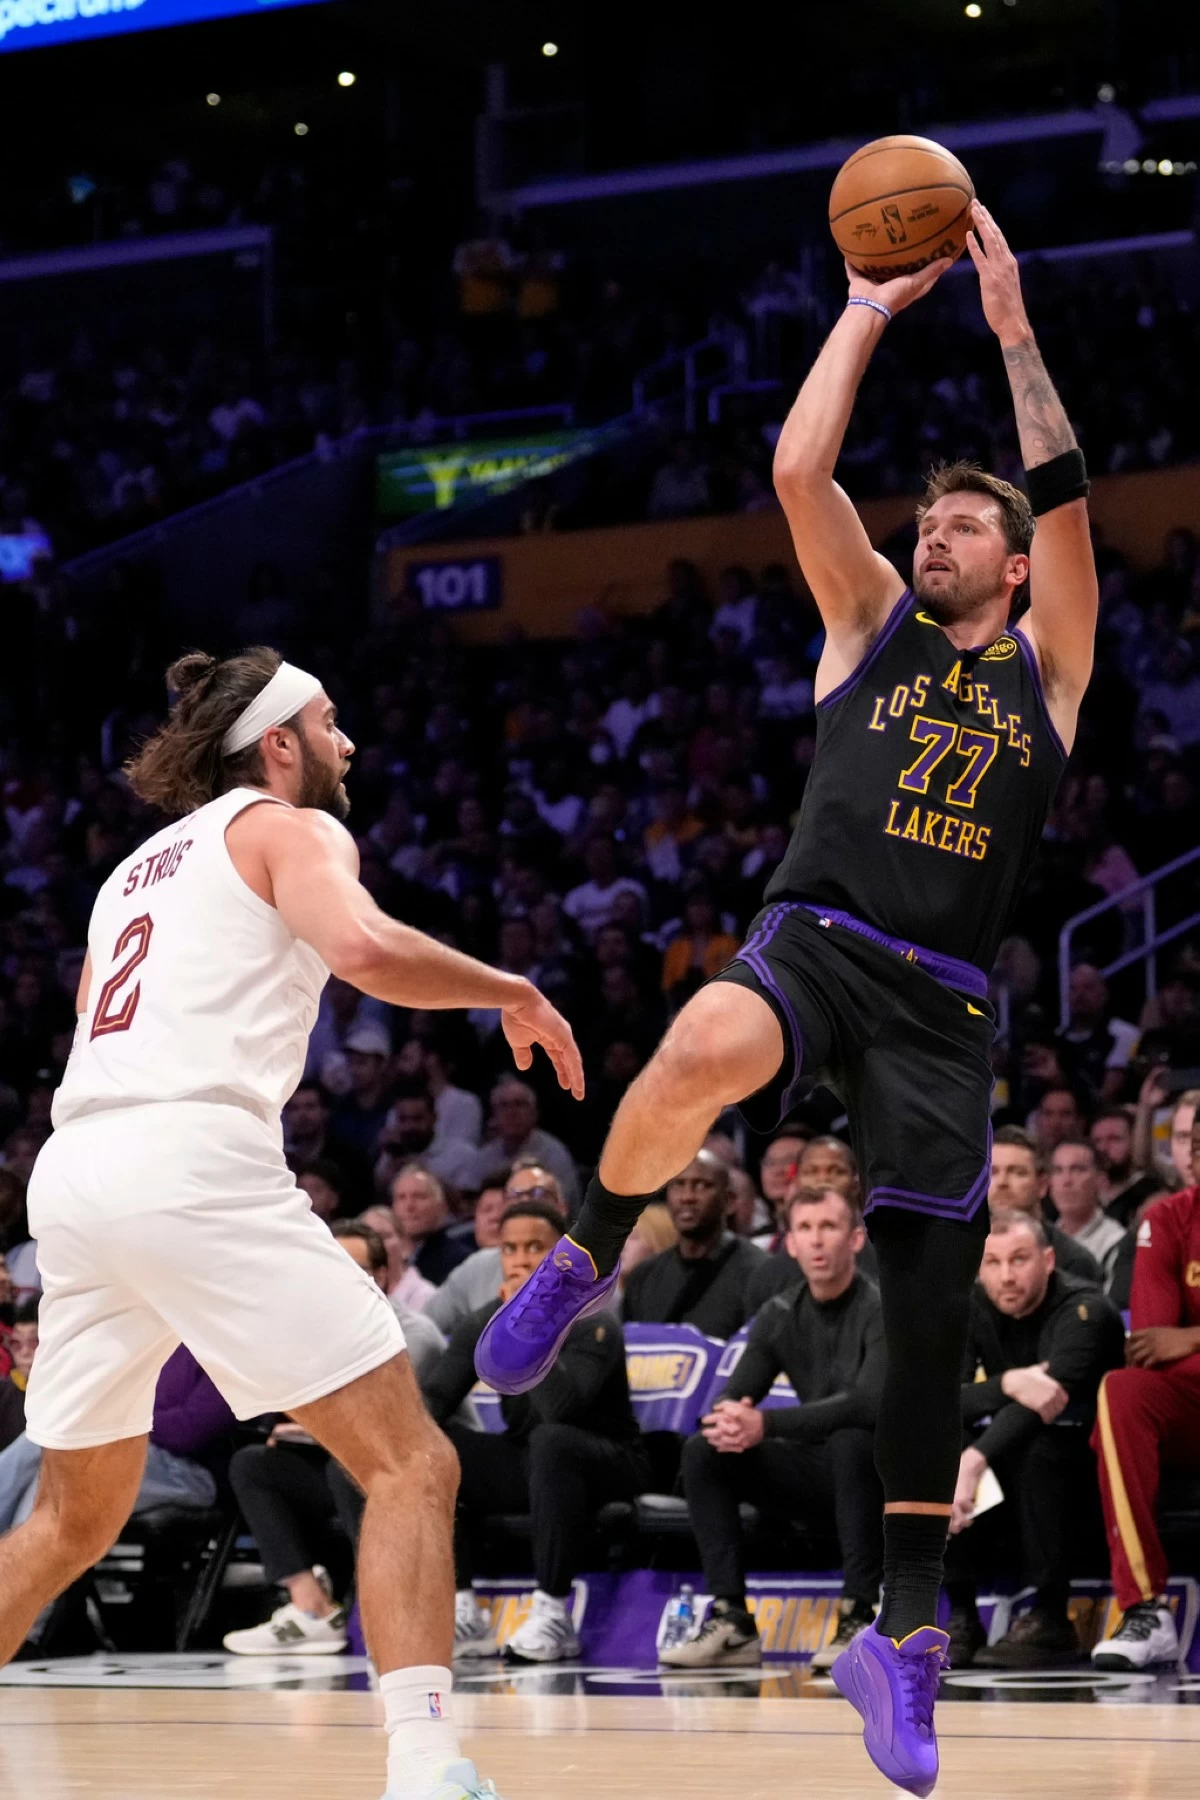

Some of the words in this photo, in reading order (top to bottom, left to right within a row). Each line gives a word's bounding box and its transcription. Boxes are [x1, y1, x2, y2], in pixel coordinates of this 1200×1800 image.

[417, 563, 486, 608] 101
[868, 674, 932, 732] LOS
[941, 660, 1032, 767] AGELES
[898, 714, 999, 808] 77
[884, 799, 992, 860] LAKERS
[123, 839, 194, 897] STRUS
[89, 912, 154, 1043] 2
[626, 1353, 684, 1391] RIME
[744, 1595, 842, 1651] RIM
